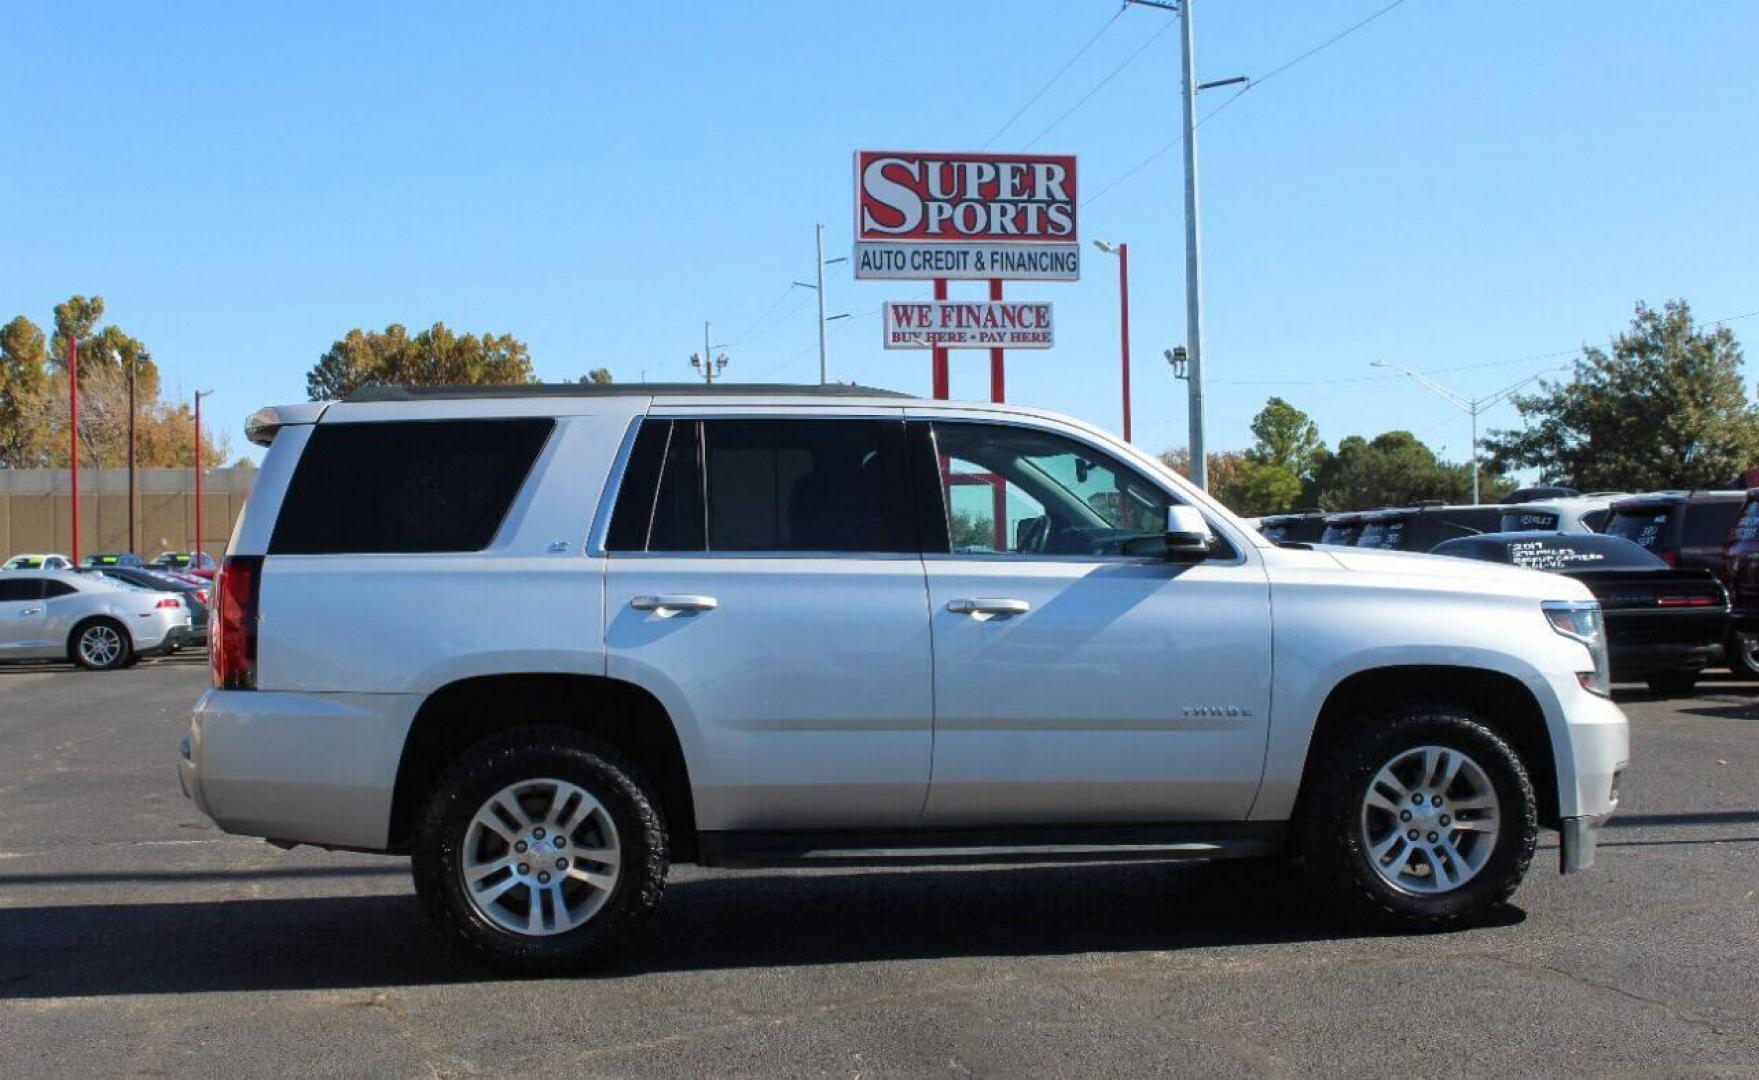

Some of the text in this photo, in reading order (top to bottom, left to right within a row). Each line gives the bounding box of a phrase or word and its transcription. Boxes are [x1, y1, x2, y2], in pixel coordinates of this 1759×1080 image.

[861, 250, 1077, 272] AUTO CREDIT & FINANCING
[892, 304, 1050, 329] WE FINANCE
[926, 332, 967, 343] HERE
[979, 332, 1006, 343] PAY
[1011, 332, 1051, 343] HERE
